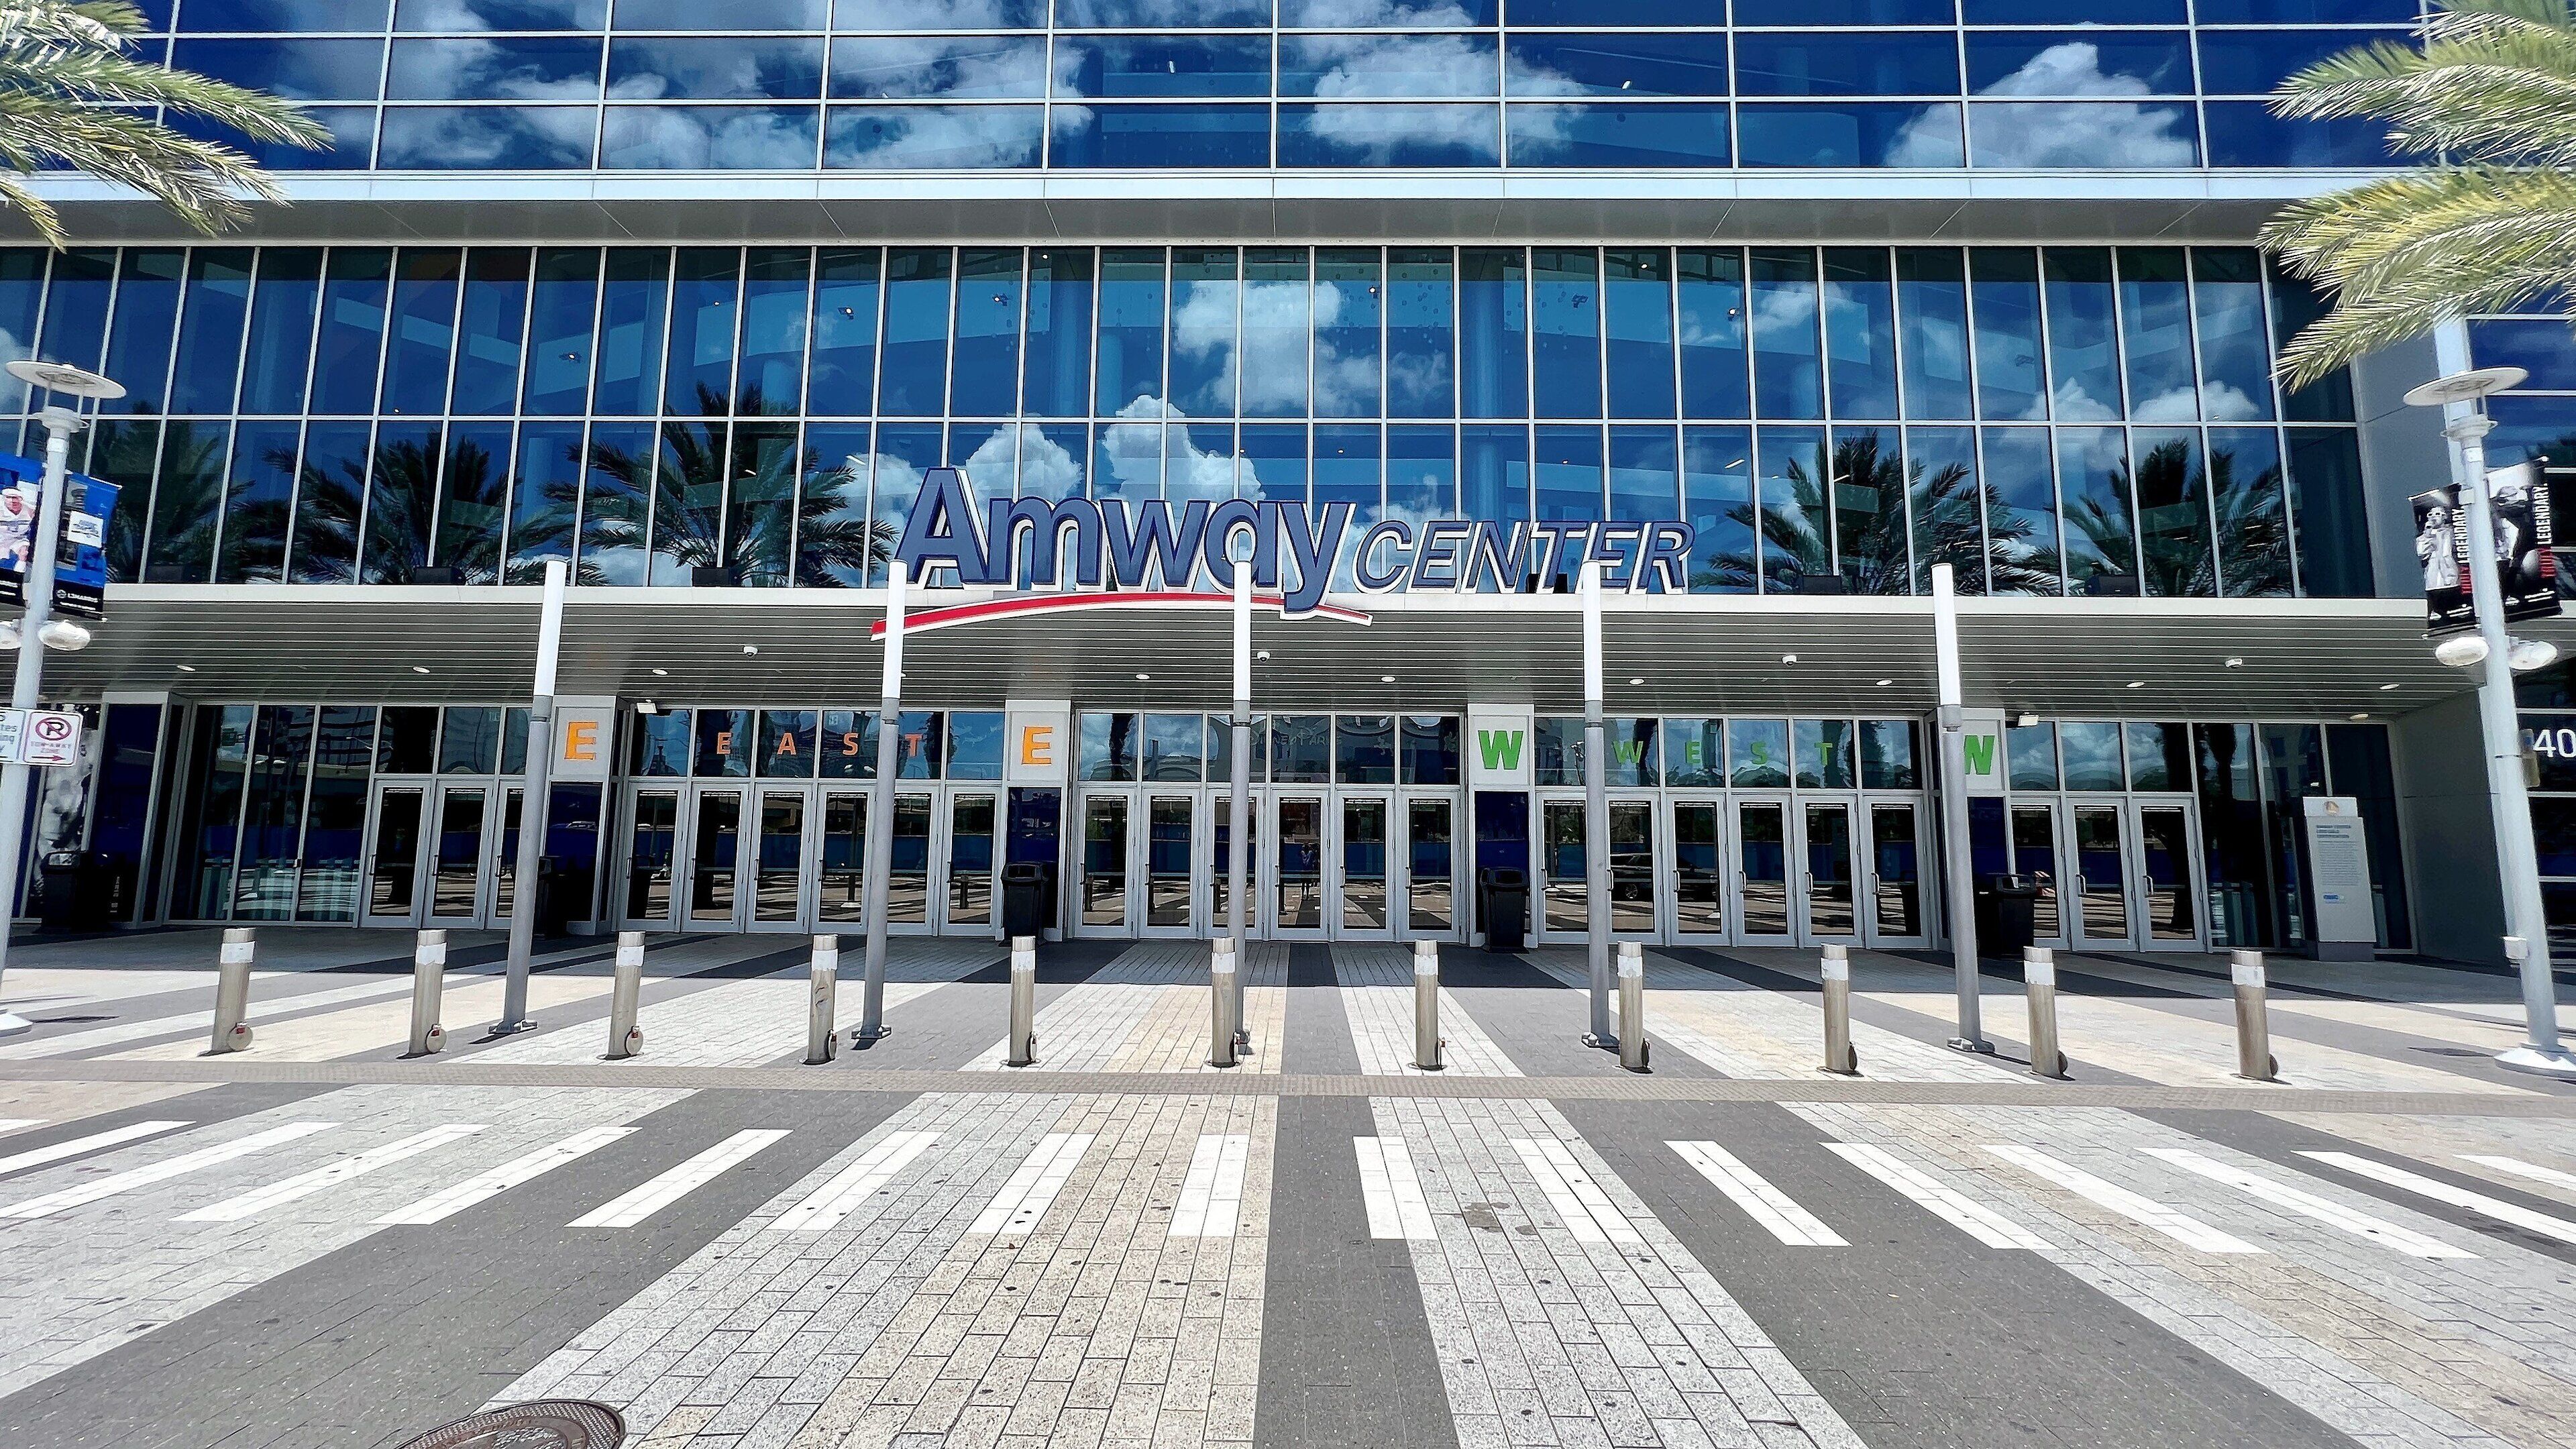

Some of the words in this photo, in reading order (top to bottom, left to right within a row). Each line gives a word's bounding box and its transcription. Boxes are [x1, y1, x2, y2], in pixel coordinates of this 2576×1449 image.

[2532, 483, 2552, 545] LEGENDARY.
[895, 467, 1355, 621] Amway
[1354, 519, 1695, 594] CENTER
[564, 720, 598, 760] E
[1022, 726, 1053, 765] E
[1478, 729, 1524, 770] W
[2533, 729, 2576, 758] 40
